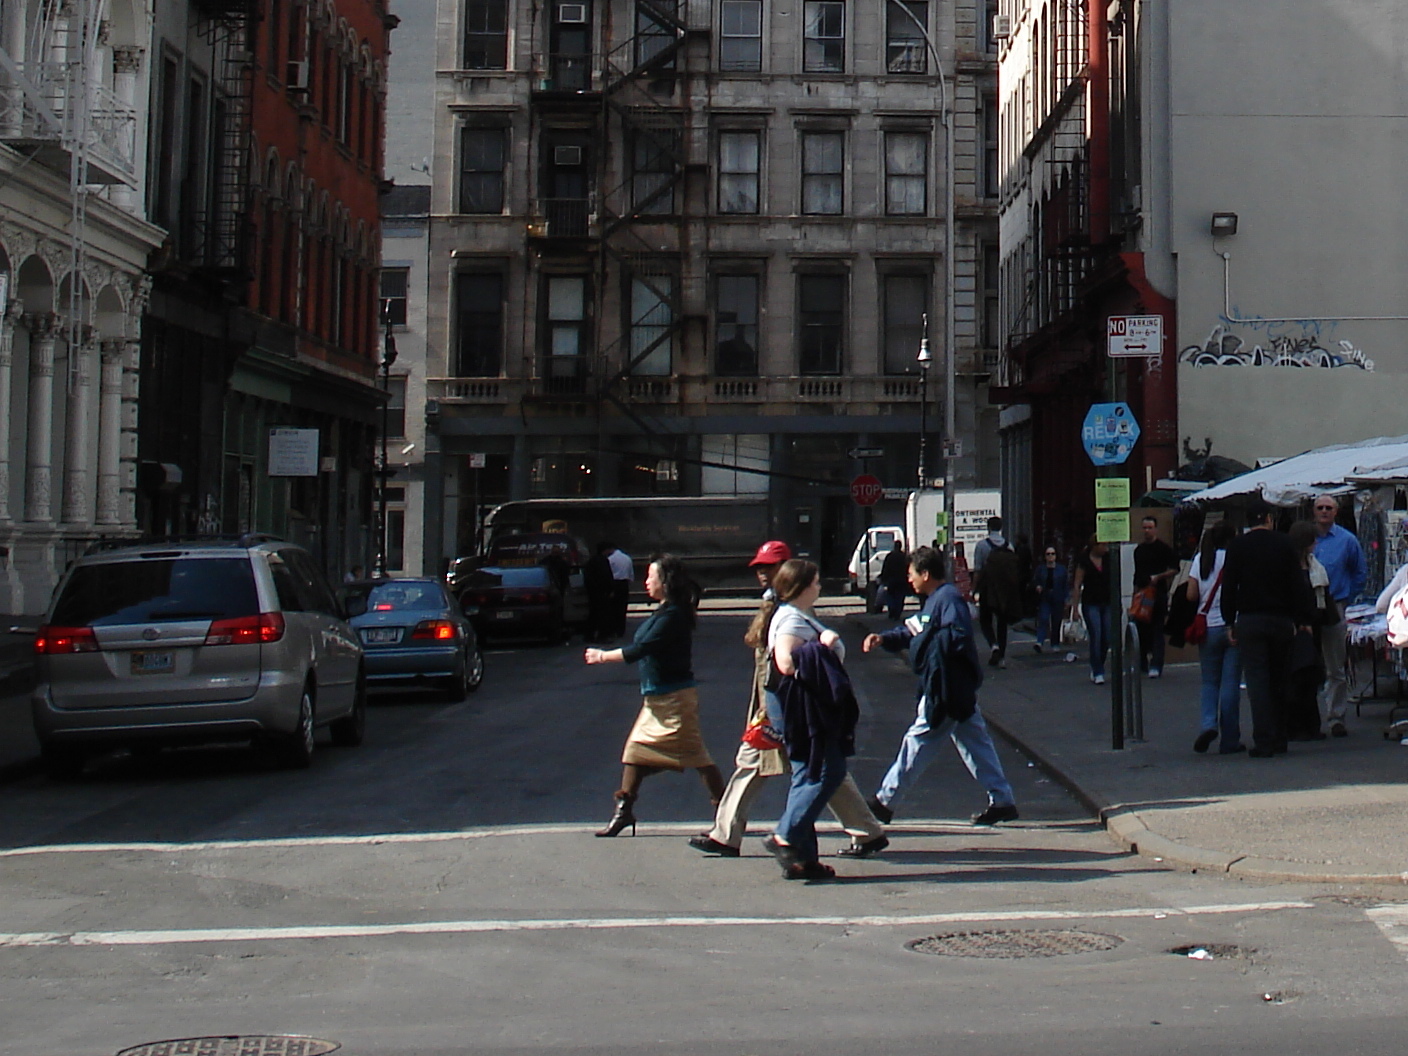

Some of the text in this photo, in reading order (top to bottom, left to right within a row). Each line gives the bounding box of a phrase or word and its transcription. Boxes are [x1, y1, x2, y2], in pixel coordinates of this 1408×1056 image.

[1110, 320, 1125, 333] NO
[852, 484, 880, 497] STOP
[956, 508, 997, 517] ONTINENTAL
